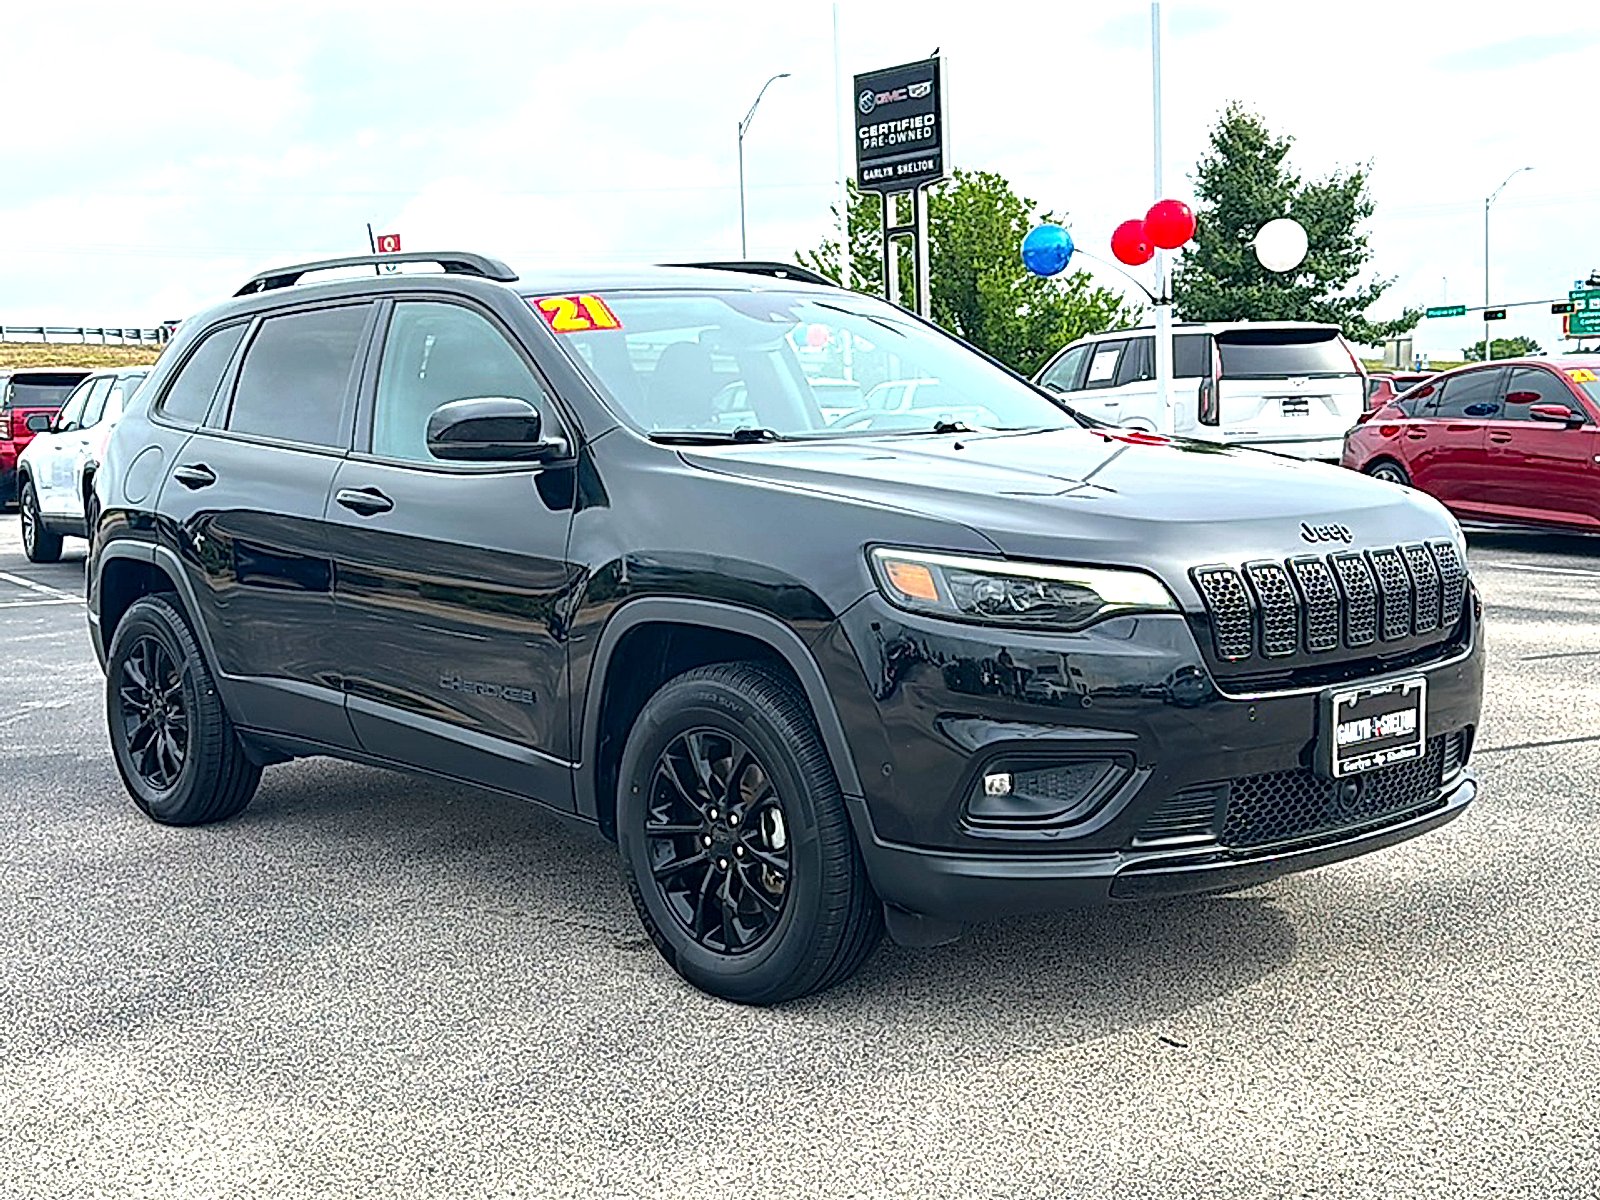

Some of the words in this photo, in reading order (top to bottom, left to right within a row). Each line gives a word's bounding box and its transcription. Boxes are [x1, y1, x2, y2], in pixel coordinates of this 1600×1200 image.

[875, 88, 908, 105] GMC
[859, 113, 935, 139] CERTIFIED
[863, 126, 932, 149] PRE-OWNED
[897, 159, 934, 176] SHELTON
[538, 294, 617, 332] 21
[1299, 520, 1354, 545] Jeep
[440, 674, 537, 705] CHEROKEE
